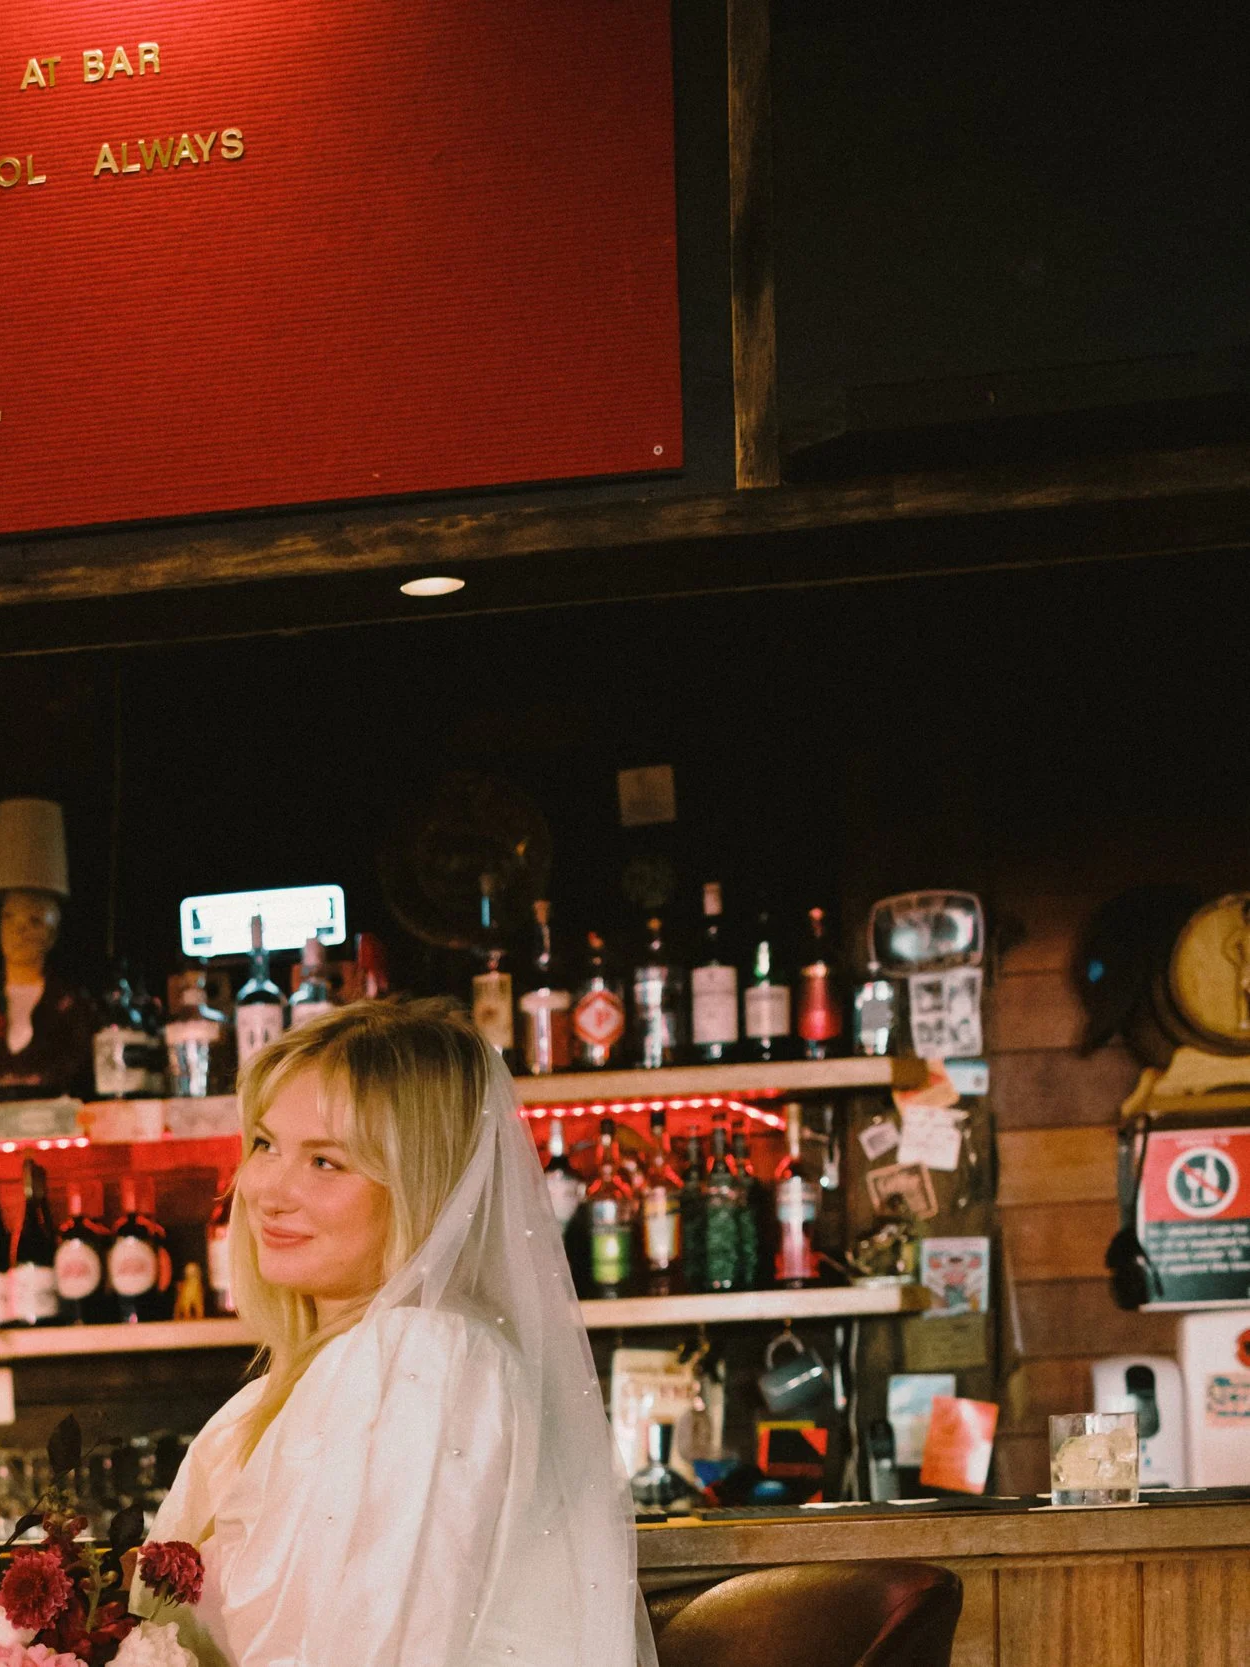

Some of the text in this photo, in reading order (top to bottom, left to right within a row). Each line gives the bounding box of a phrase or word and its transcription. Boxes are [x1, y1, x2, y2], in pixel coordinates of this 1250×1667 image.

[19, 56, 61, 91] AT
[82, 42, 161, 83] BAR
[93, 127, 244, 177] ALWAYS
